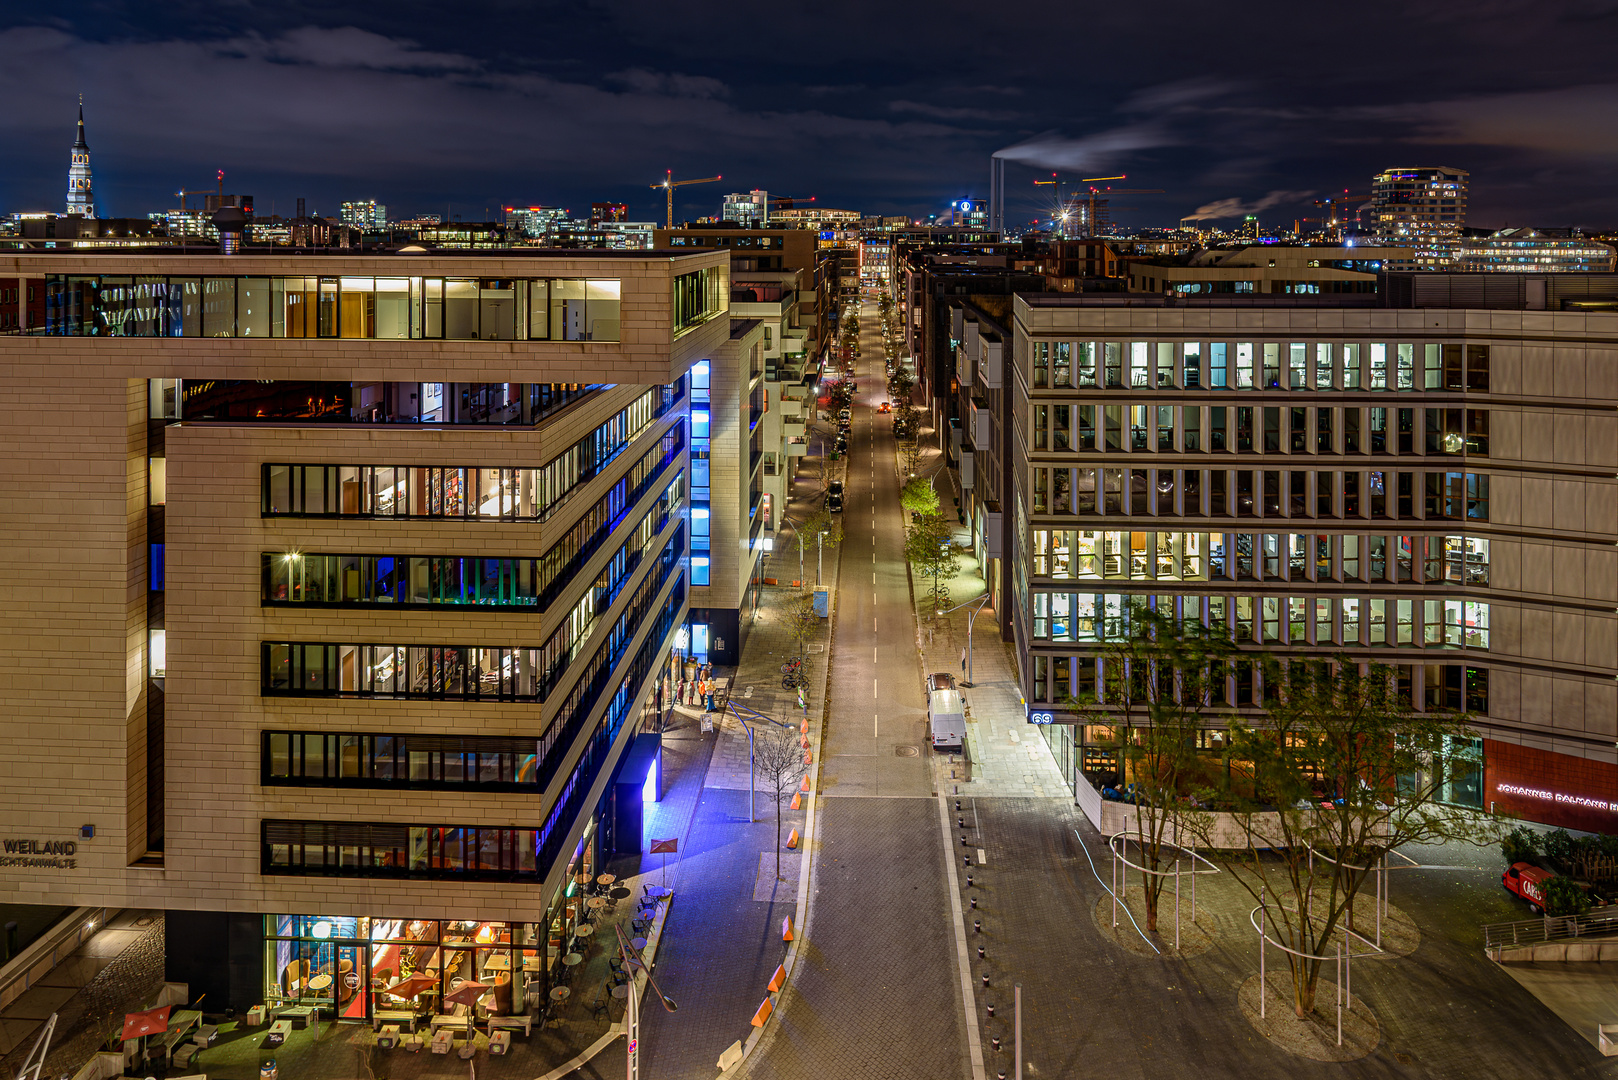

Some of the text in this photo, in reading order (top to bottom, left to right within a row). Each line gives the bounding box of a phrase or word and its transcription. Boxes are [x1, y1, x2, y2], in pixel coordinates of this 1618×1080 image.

[1032, 713, 1052, 725] 69
[1497, 784, 1553, 800] JOHANNES
[1555, 793, 1608, 810] DALMANN
[3, 839, 76, 855] WEILAND
